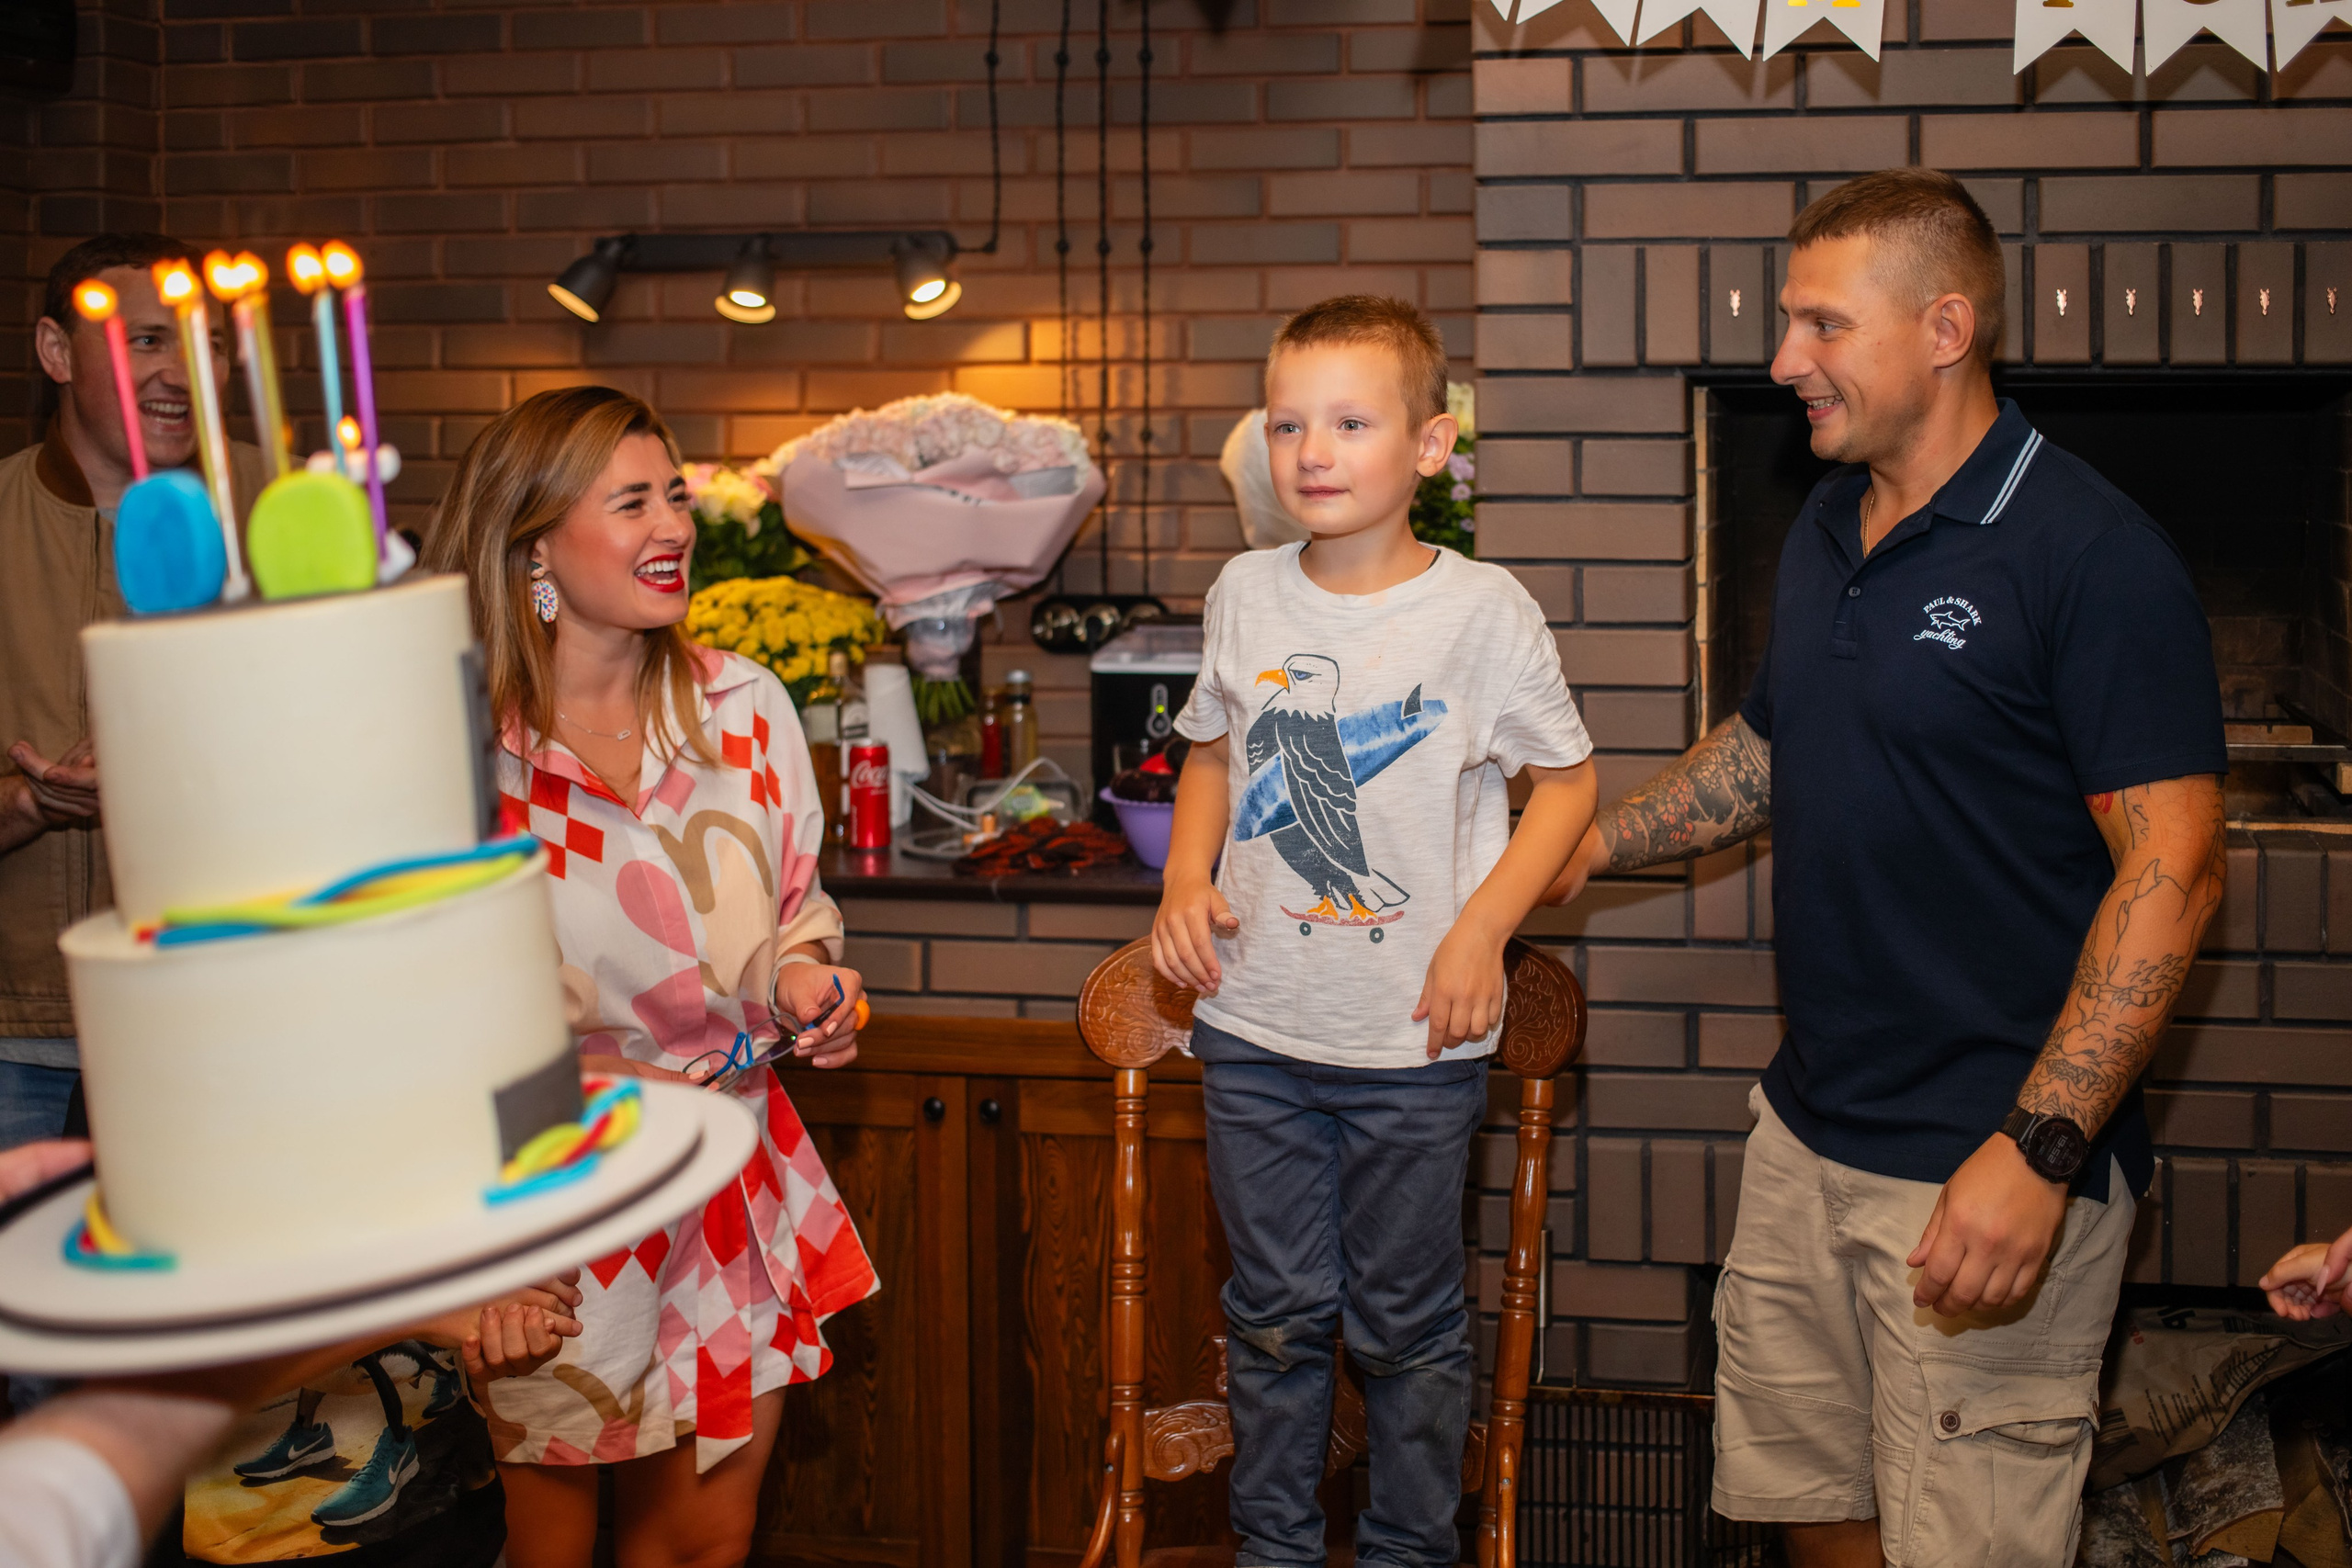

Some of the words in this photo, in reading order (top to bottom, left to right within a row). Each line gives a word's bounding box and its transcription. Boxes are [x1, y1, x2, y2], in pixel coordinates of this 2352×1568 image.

[1923, 597, 1945, 614] PAUL
[1954, 597, 1982, 626] SHARK
[1913, 629, 1966, 649] yachting
[2047, 1134, 2069, 1164] 19:52
